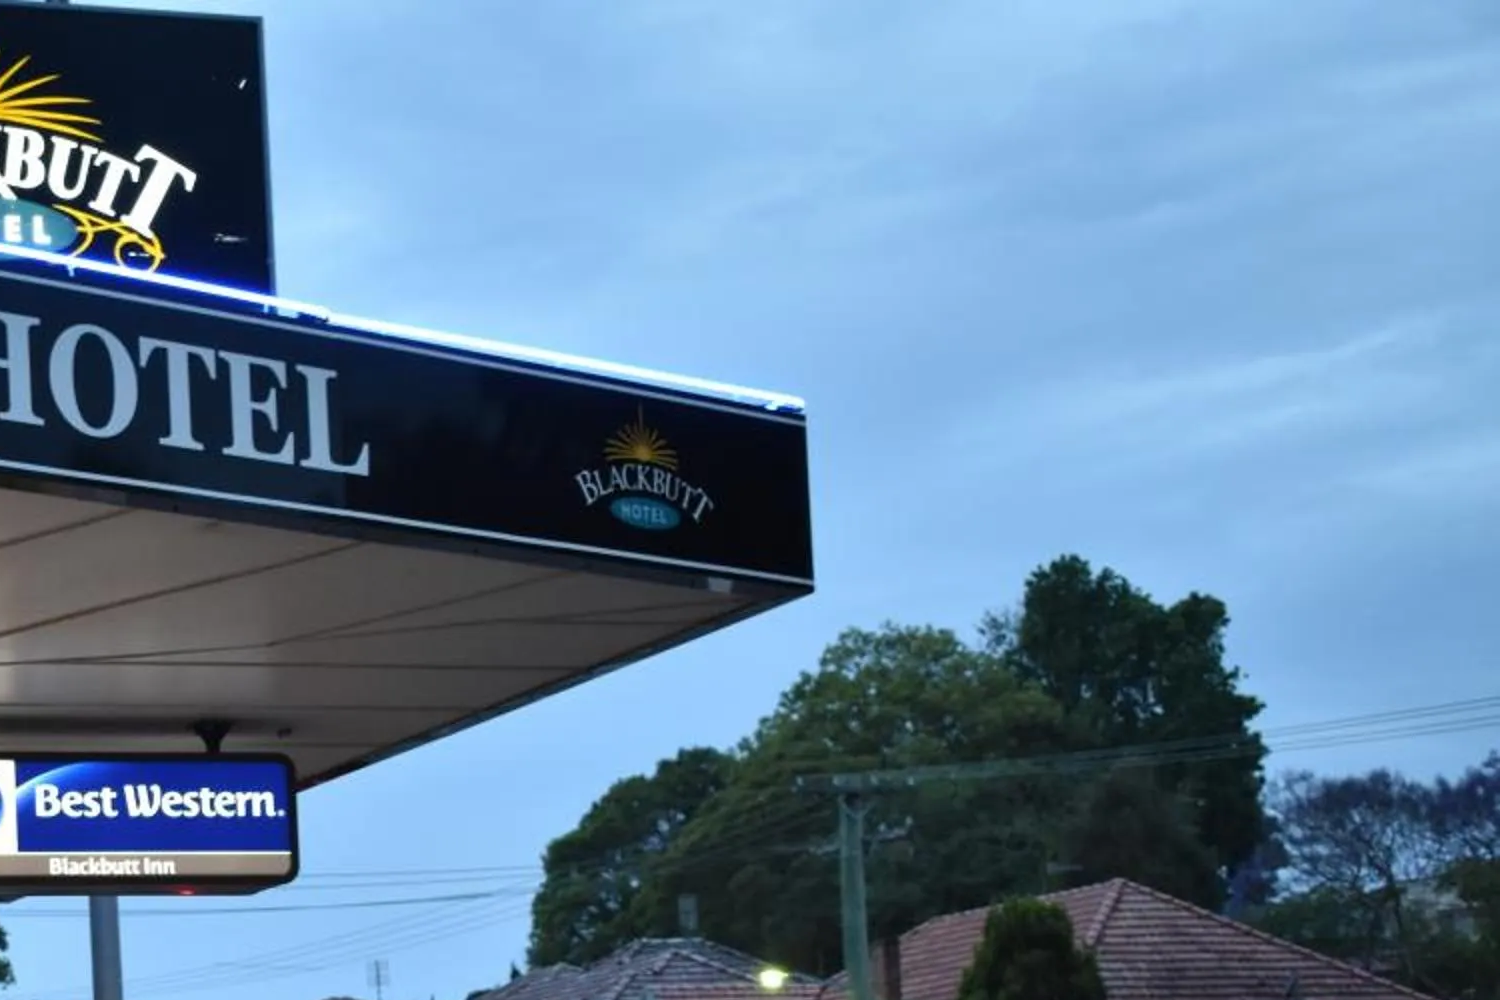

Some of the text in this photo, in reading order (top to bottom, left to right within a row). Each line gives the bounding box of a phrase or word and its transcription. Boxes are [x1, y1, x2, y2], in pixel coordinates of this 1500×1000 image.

[574, 462, 715, 525] BLACKBUTT
[620, 503, 668, 526] HOTEL
[33, 783, 119, 818] Best
[49, 857, 177, 876] Blackbutt Inn
